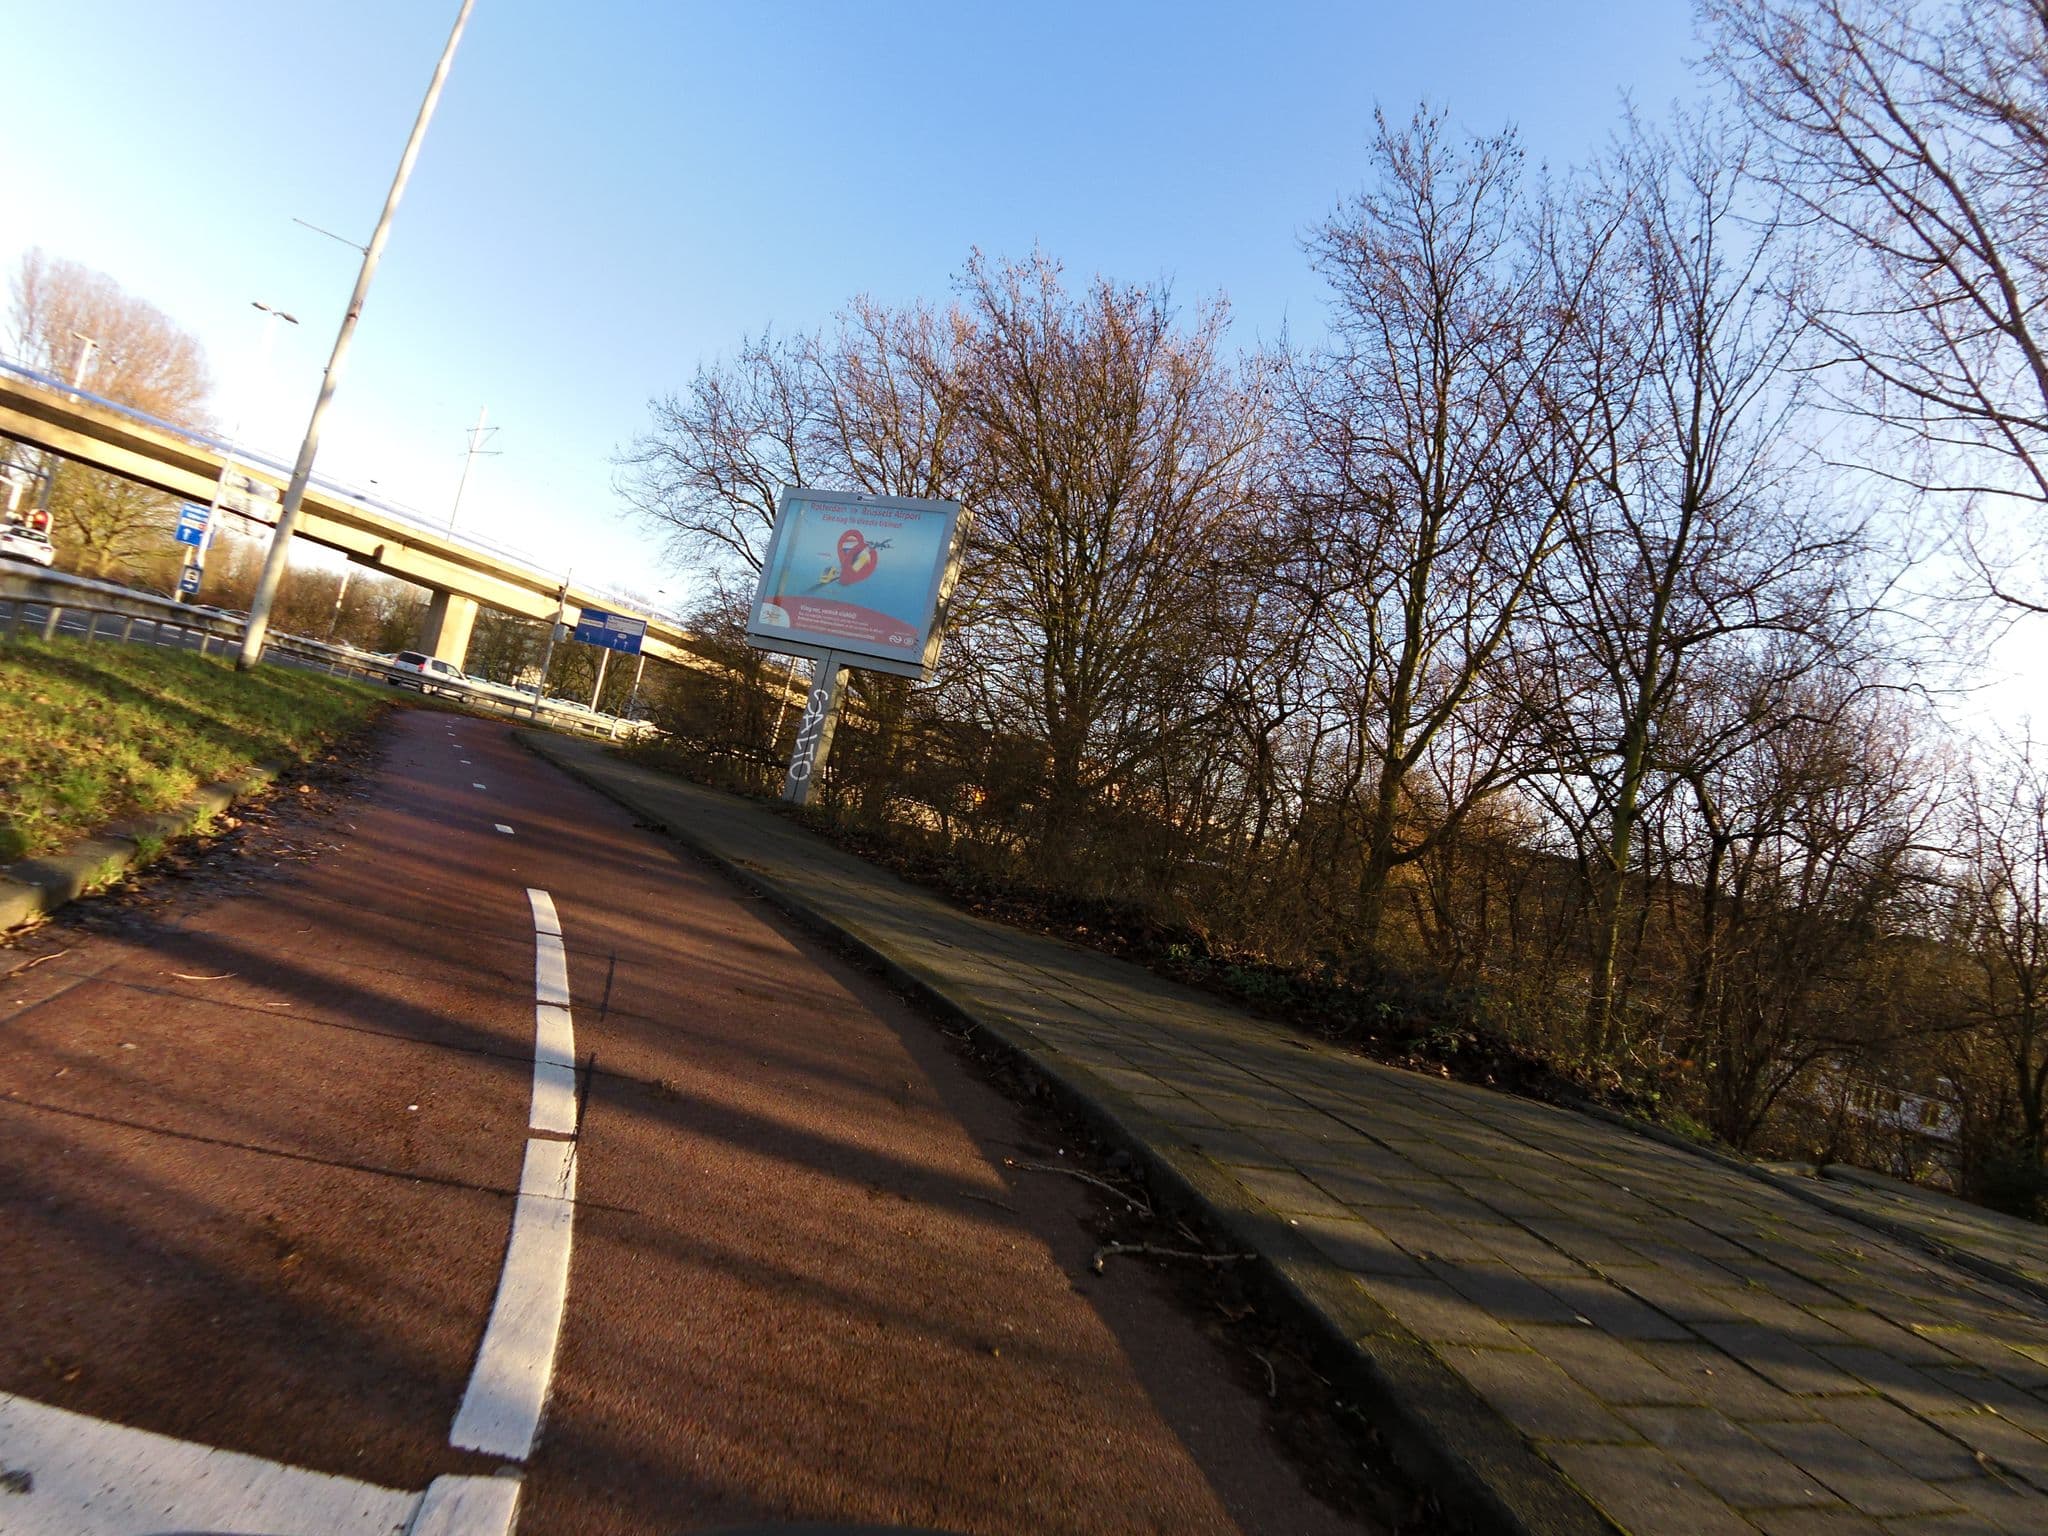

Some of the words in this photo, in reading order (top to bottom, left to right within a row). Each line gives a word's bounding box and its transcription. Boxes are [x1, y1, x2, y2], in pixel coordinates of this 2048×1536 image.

[862, 507, 893, 518] Brussels
[895, 510, 921, 521] Airport
[789, 689, 828, 781] SALTO
